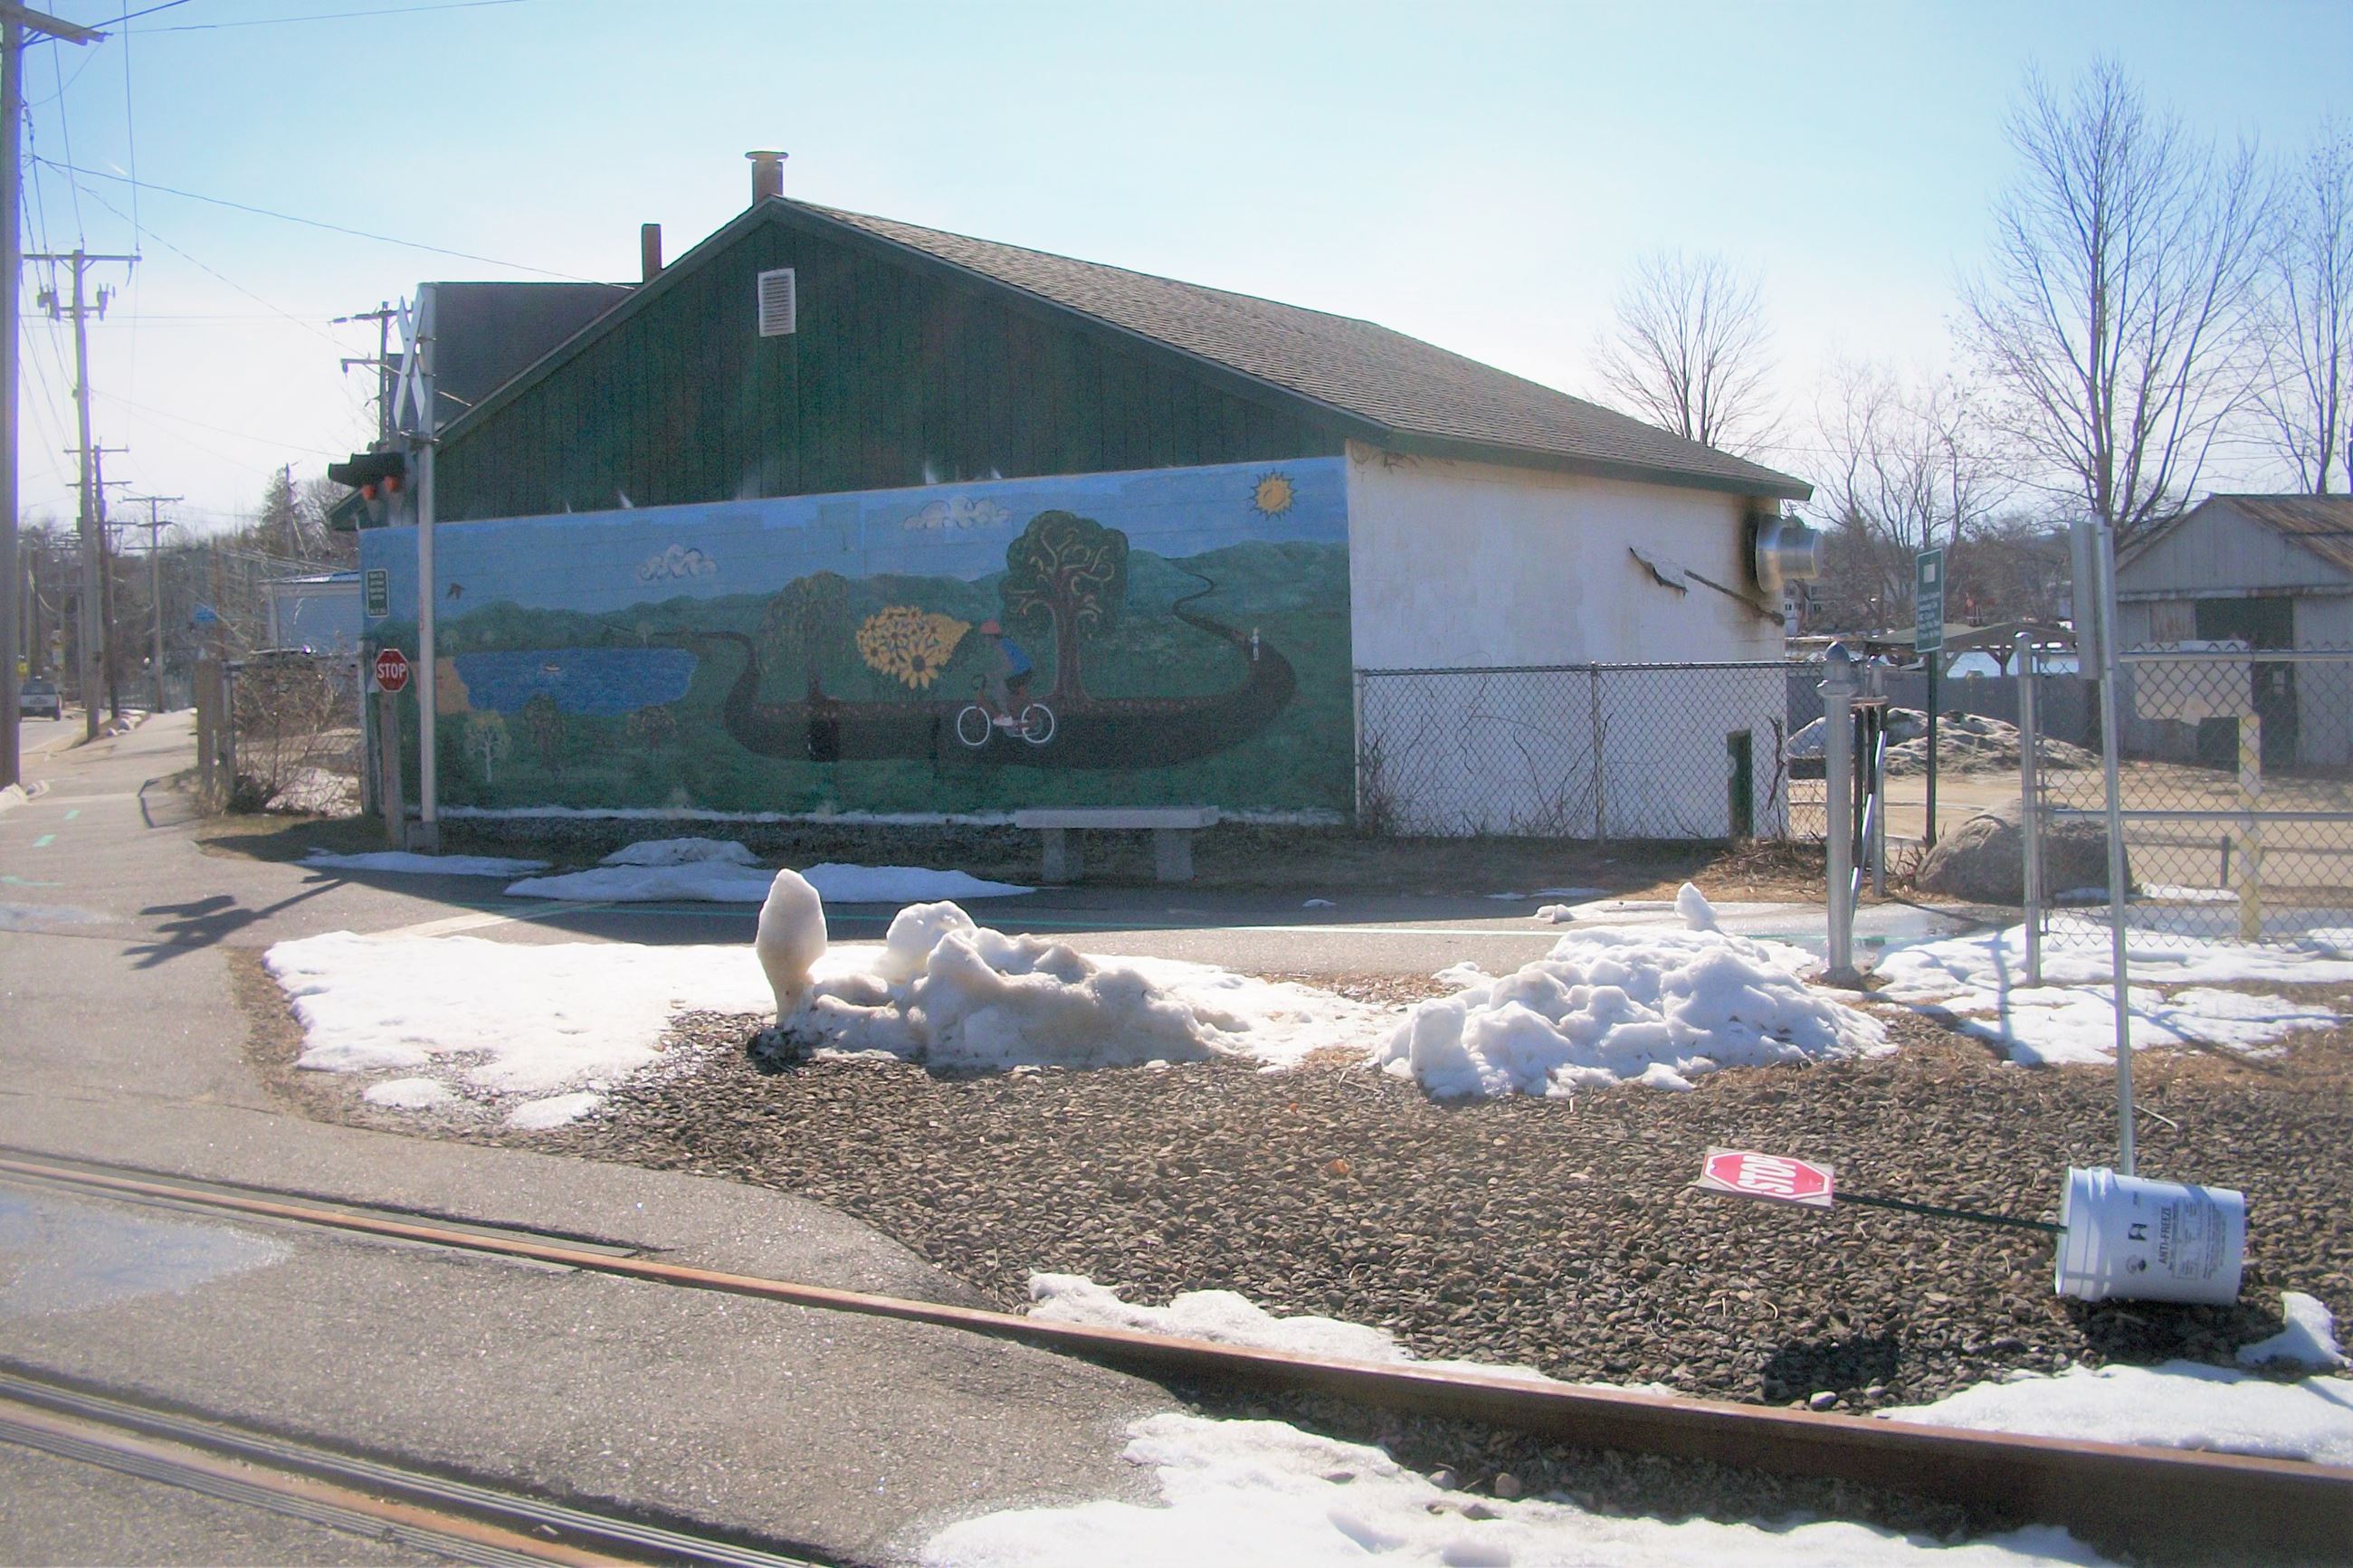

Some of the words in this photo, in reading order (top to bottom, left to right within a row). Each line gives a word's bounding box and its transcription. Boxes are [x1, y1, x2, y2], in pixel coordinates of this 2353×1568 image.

[376, 662, 406, 679] STOP
[1737, 1155, 1797, 1194] STOP
[2158, 1205, 2172, 1265] ANTI-FREEZE
